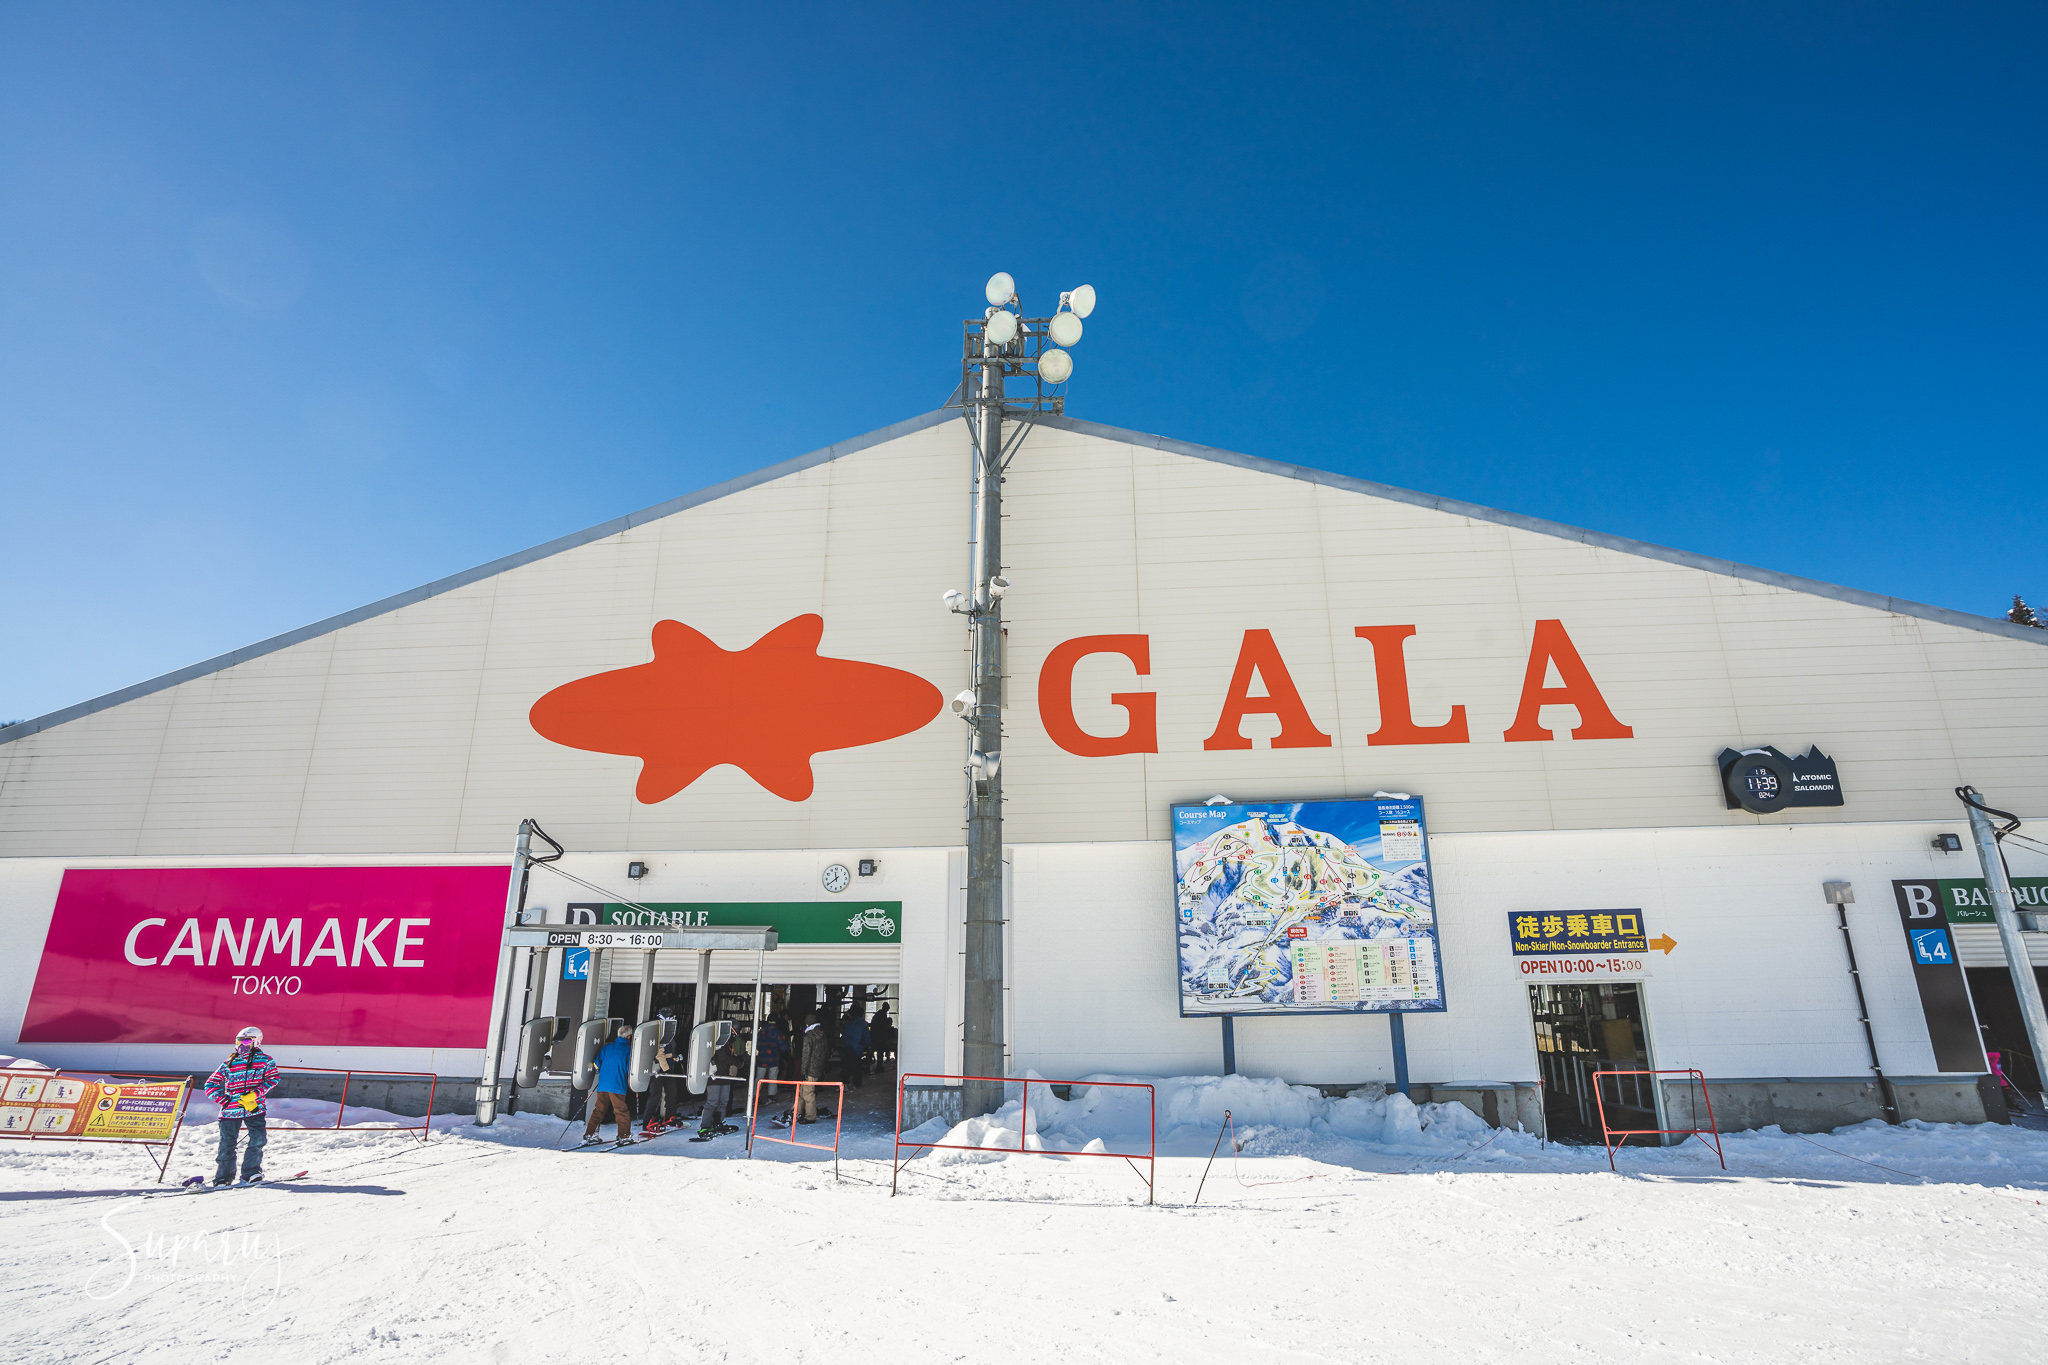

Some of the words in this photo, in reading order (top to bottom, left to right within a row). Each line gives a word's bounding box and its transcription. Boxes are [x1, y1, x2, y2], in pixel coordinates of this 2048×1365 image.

[1038, 619, 1634, 758] GALA
[1748, 776, 1778, 790] 11:39
[1794, 784, 1834, 792] SALOMON
[1179, 811, 1208, 819] Course
[1209, 810, 1227, 819] Map
[1901, 885, 1937, 919] B
[572, 908, 597, 925] D
[611, 911, 709, 926] SOCIABLE
[1515, 913, 1639, 939] 徒歩乗車口
[123, 917, 432, 968] CANMAKE
[549, 933, 580, 945] OPEN
[587, 934, 613, 945] 8:30
[629, 934, 662, 946] 16:00
[1515, 940, 1612, 952] Non-Skier/Non-Snowboarder
[1613, 939, 1645, 950] Entrance
[1933, 942, 1947, 960] 4
[578, 960, 589, 976] 4
[231, 975, 303, 996] TOKYO
